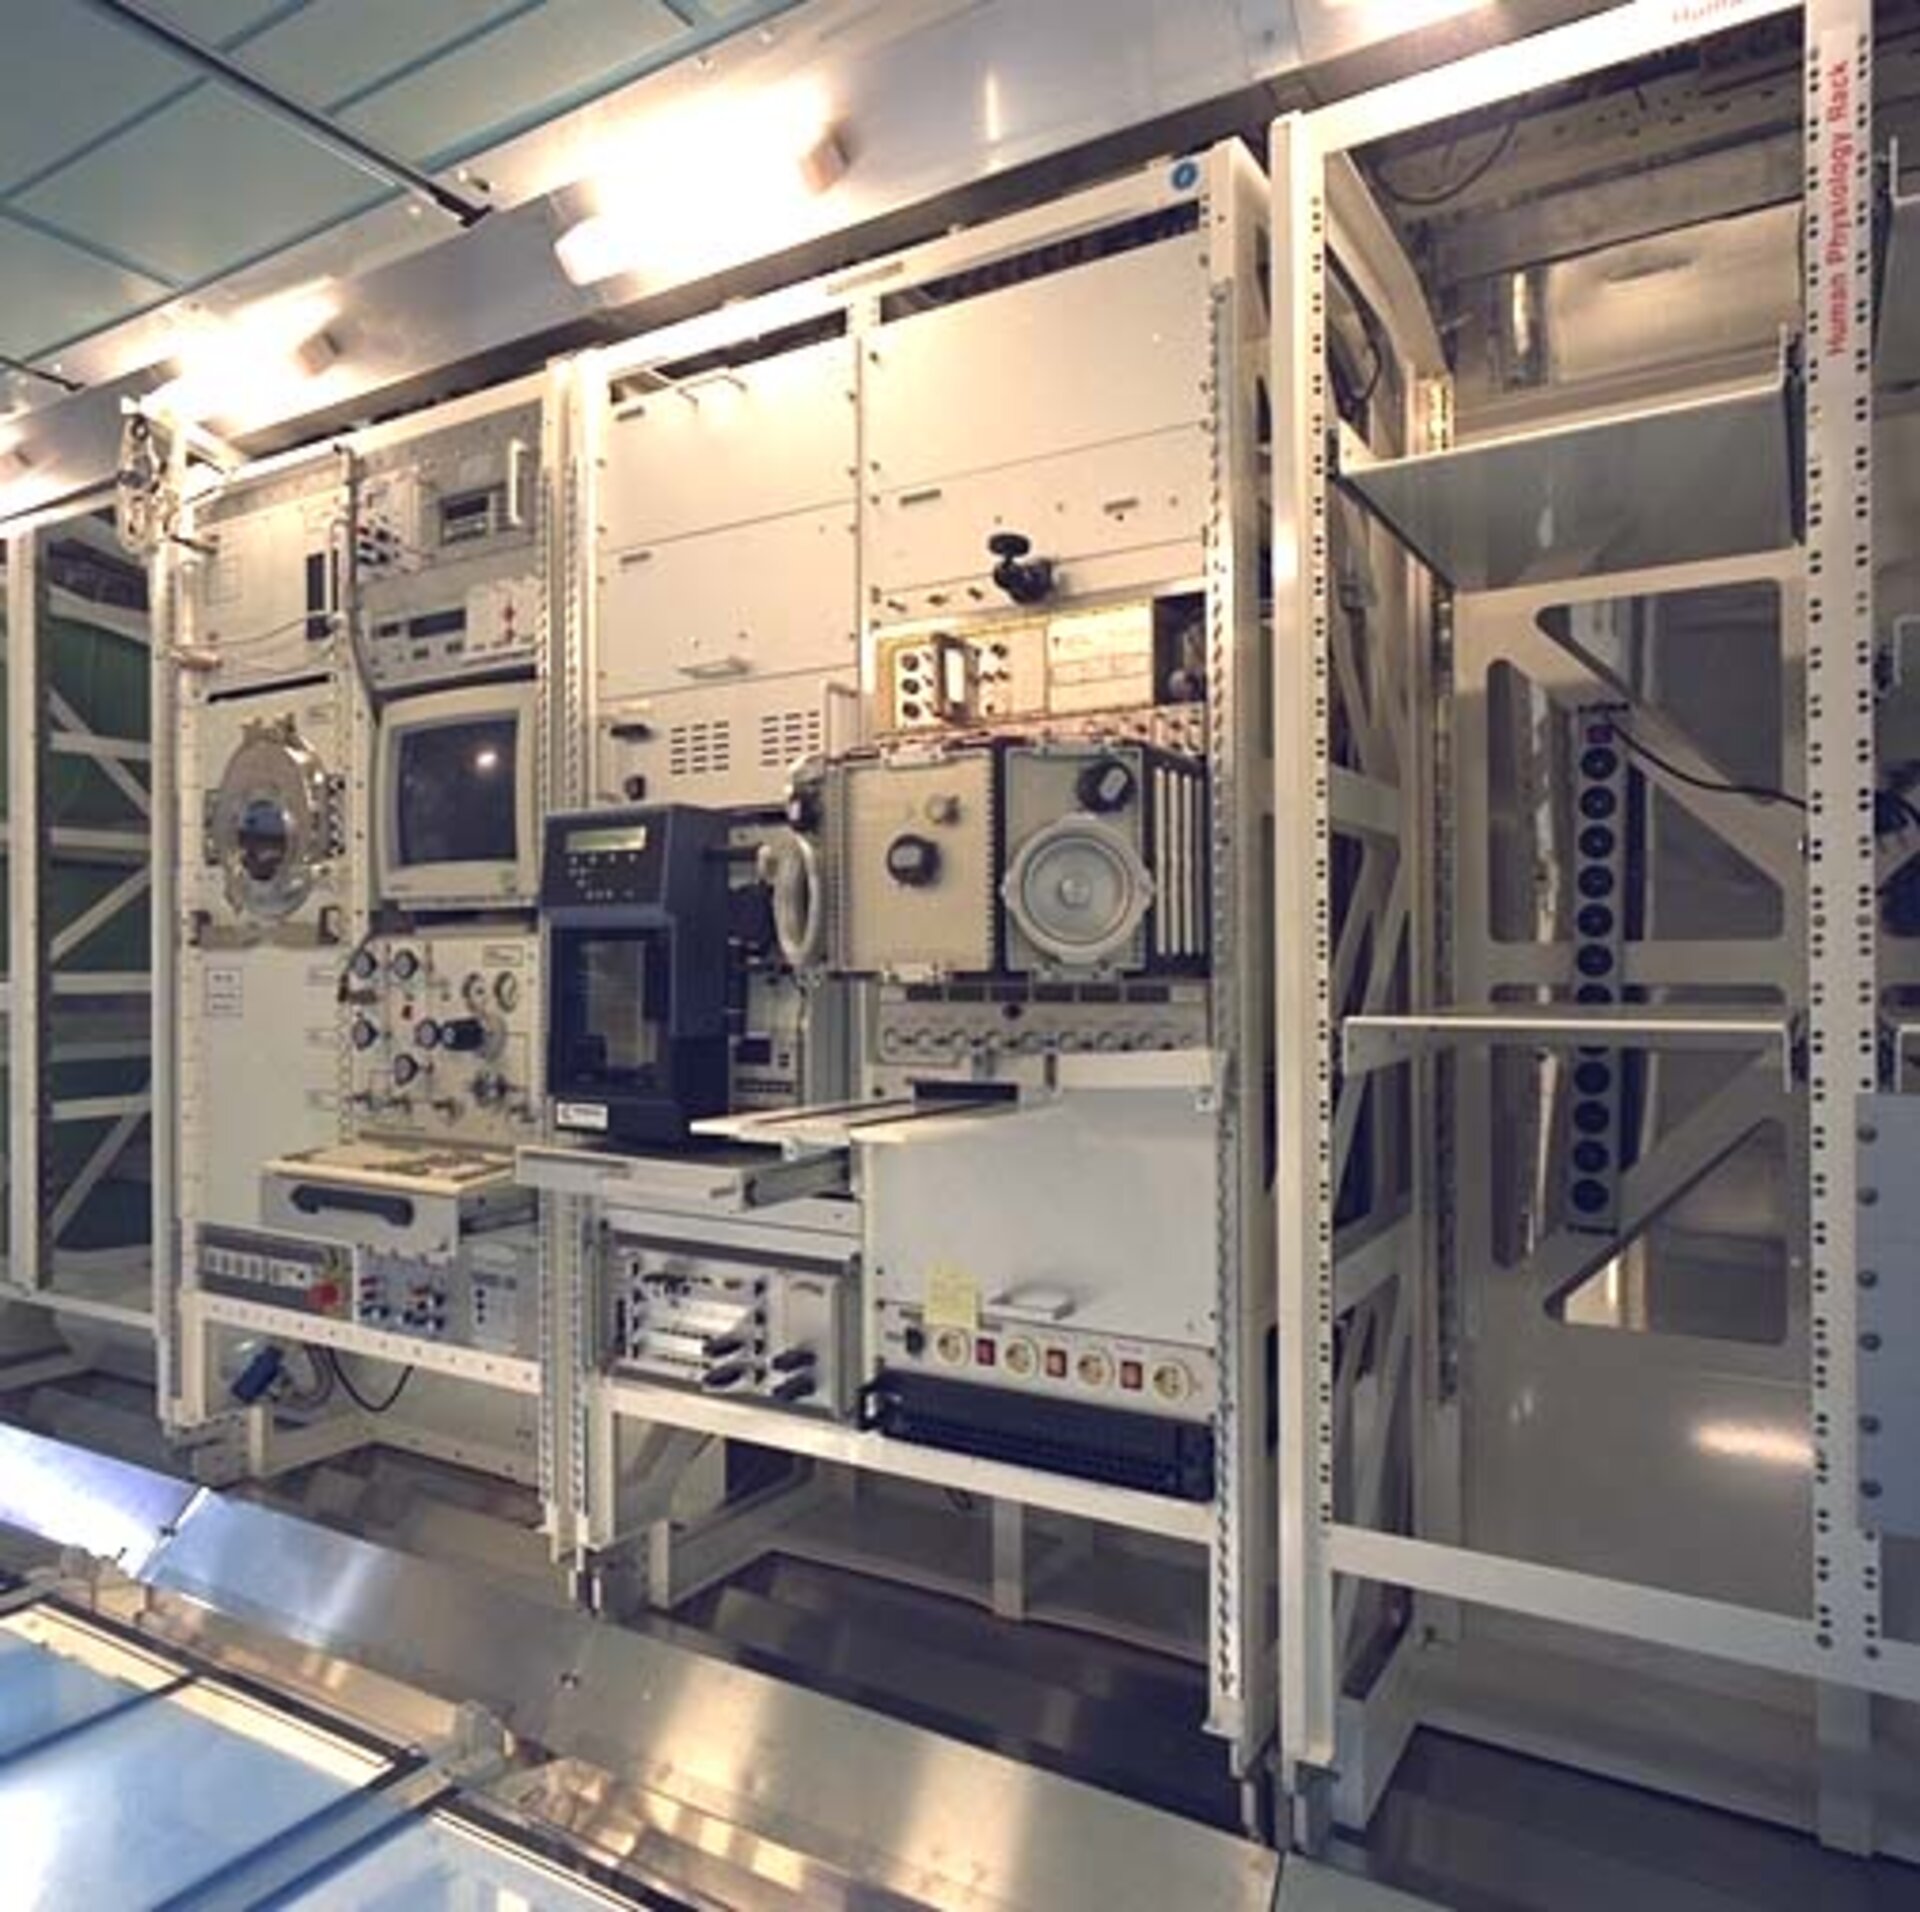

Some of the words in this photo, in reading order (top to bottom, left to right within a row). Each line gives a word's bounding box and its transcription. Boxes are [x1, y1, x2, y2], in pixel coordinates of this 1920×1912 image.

[1826, 61, 1849, 122] Rack
[1825, 132, 1853, 266] Physiology
[1826, 273, 1849, 357] Human
